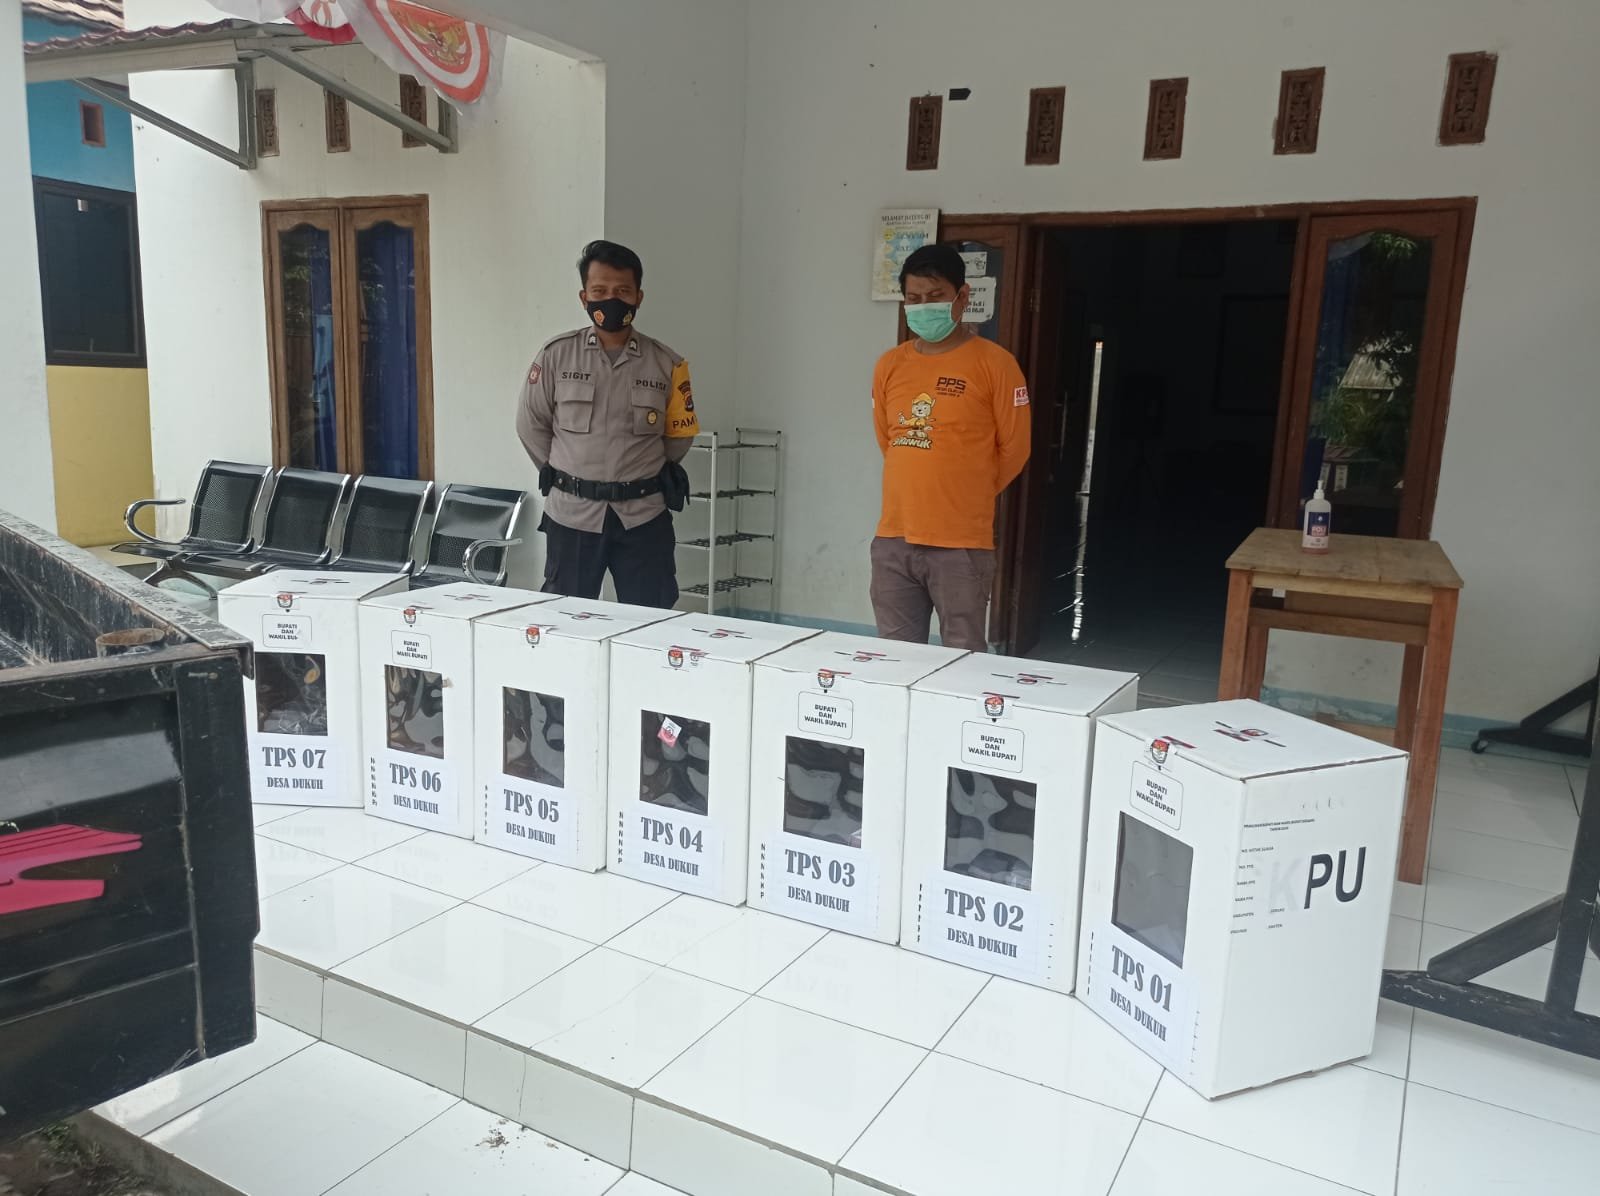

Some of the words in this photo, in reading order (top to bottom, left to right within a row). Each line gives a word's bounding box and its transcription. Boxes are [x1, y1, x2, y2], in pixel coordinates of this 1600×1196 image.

[562, 371, 592, 381] SIGIT
[635, 379, 667, 391] POLISI
[936, 376, 967, 391] PPS
[815, 704, 837, 713] BUPATI
[804, 716, 824, 724] WAKIL
[825, 719, 847, 729] BUPATI
[981, 735, 1005, 744] BUPATI
[985, 743, 1001, 751] DAN
[262, 747, 297, 768] TPS
[302, 748, 327, 769] 07
[968, 747, 990, 757] WAKIL
[991, 751, 1017, 761] BUPATI
[267, 777, 290, 788] DESA
[292, 779, 323, 790] DUKUH
[390, 763, 417, 788] TPS
[421, 770, 442, 793] 06
[1146, 779, 1168, 795] BUPATI
[393, 795, 411, 809] DESA
[413, 799, 439, 815] DUKUH
[504, 788, 533, 816] TPS
[538, 798, 560, 823] 05
[1136, 790, 1154, 805] WAKIL
[1154, 800, 1176, 816] BUPATI
[1149, 789, 1163, 801] DAN
[506, 822, 526, 838] DESA
[527, 827, 556, 845] DUKUH
[640, 816, 674, 846] TPS
[679, 826, 704, 853] 04
[643, 851, 666, 868] DESA
[667, 857, 699, 876] DUKUH
[784, 848, 822, 880] TPS
[828, 859, 856, 888] 03
[787, 885, 813, 904] DESA
[814, 891, 850, 913] DUKUH
[944, 888, 986, 923] TPS
[993, 901, 1025, 932] 02
[947, 927, 975, 947] DESA
[978, 935, 1018, 959] DUKUH
[1111, 944, 1145, 993] TPS
[1149, 973, 1172, 1013] 01
[1110, 986, 1132, 1017] DESA
[1134, 1004, 1167, 1042] DUKUH
